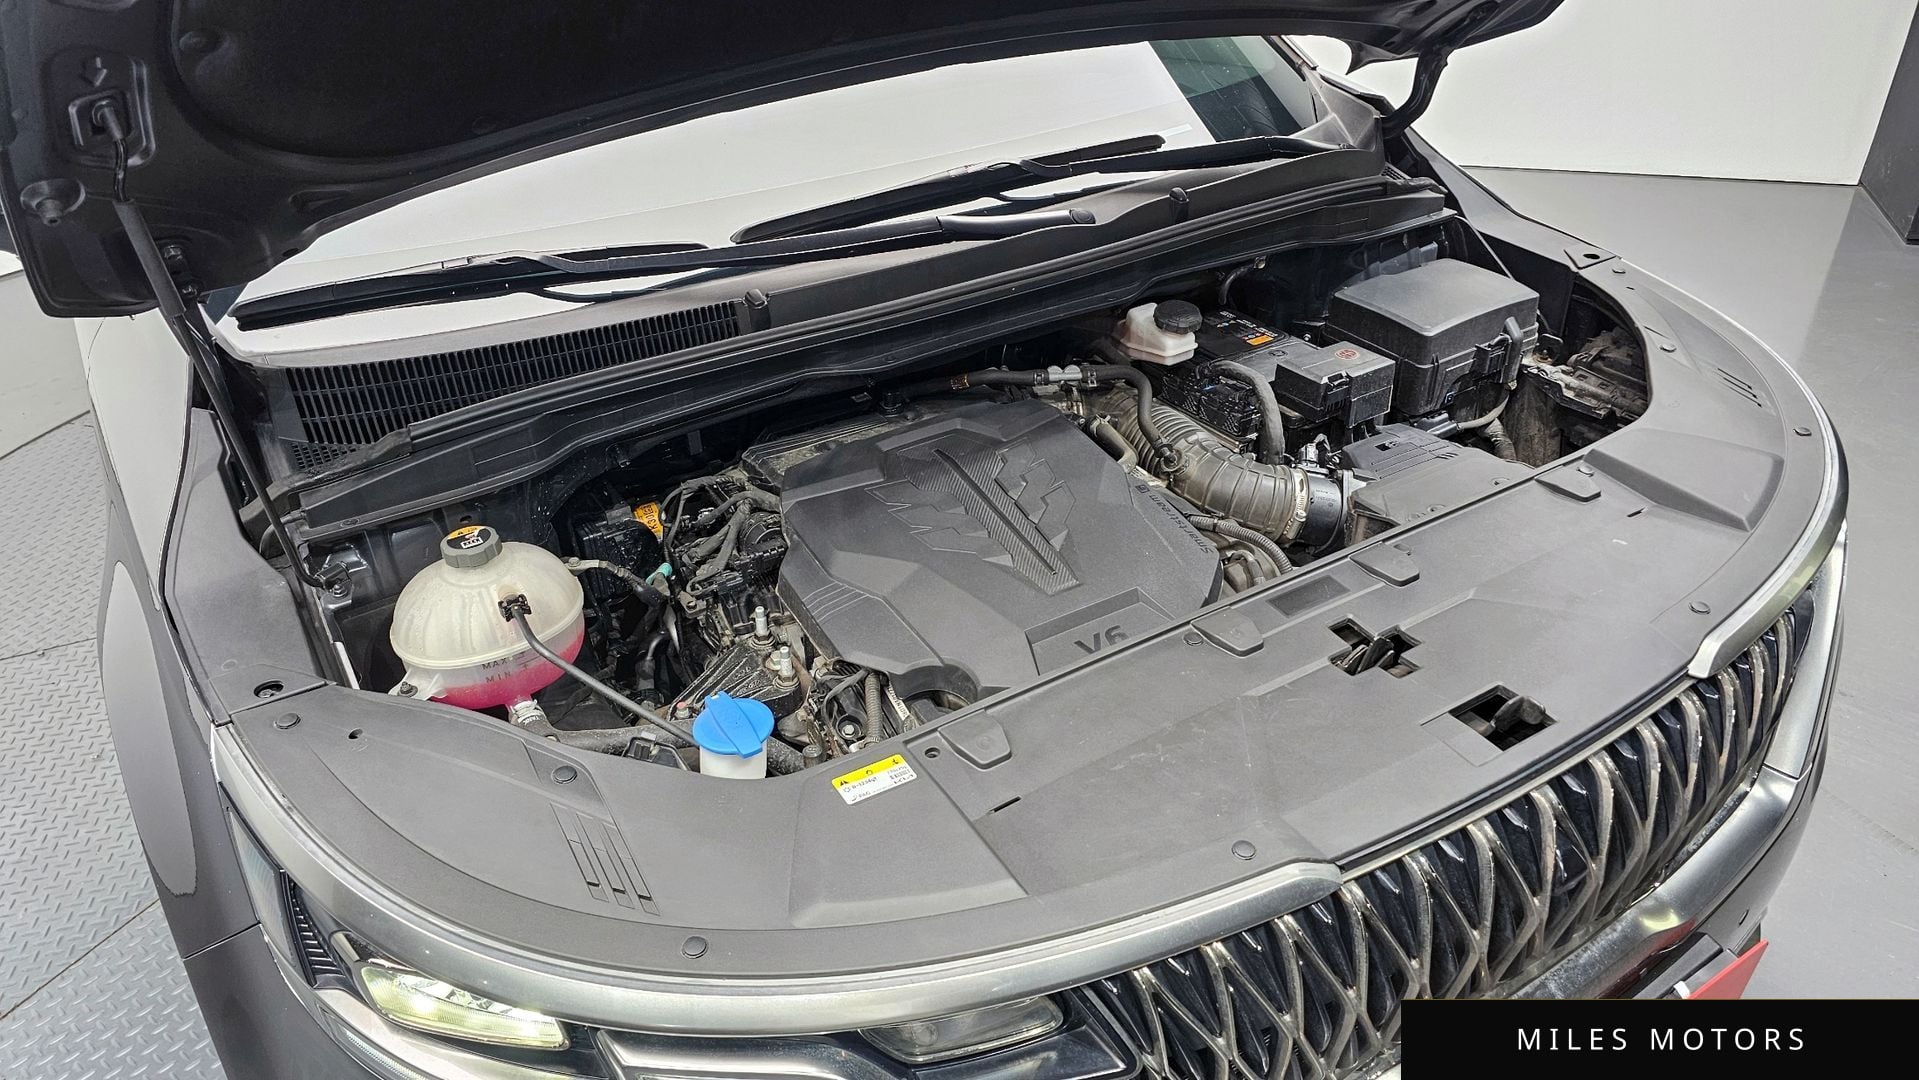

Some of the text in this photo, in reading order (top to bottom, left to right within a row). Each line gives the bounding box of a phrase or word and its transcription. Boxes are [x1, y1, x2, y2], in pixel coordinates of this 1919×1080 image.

[1073, 624, 1130, 654] V6
[481, 657, 508, 670] MAX
[485, 671, 511, 683] MIN
